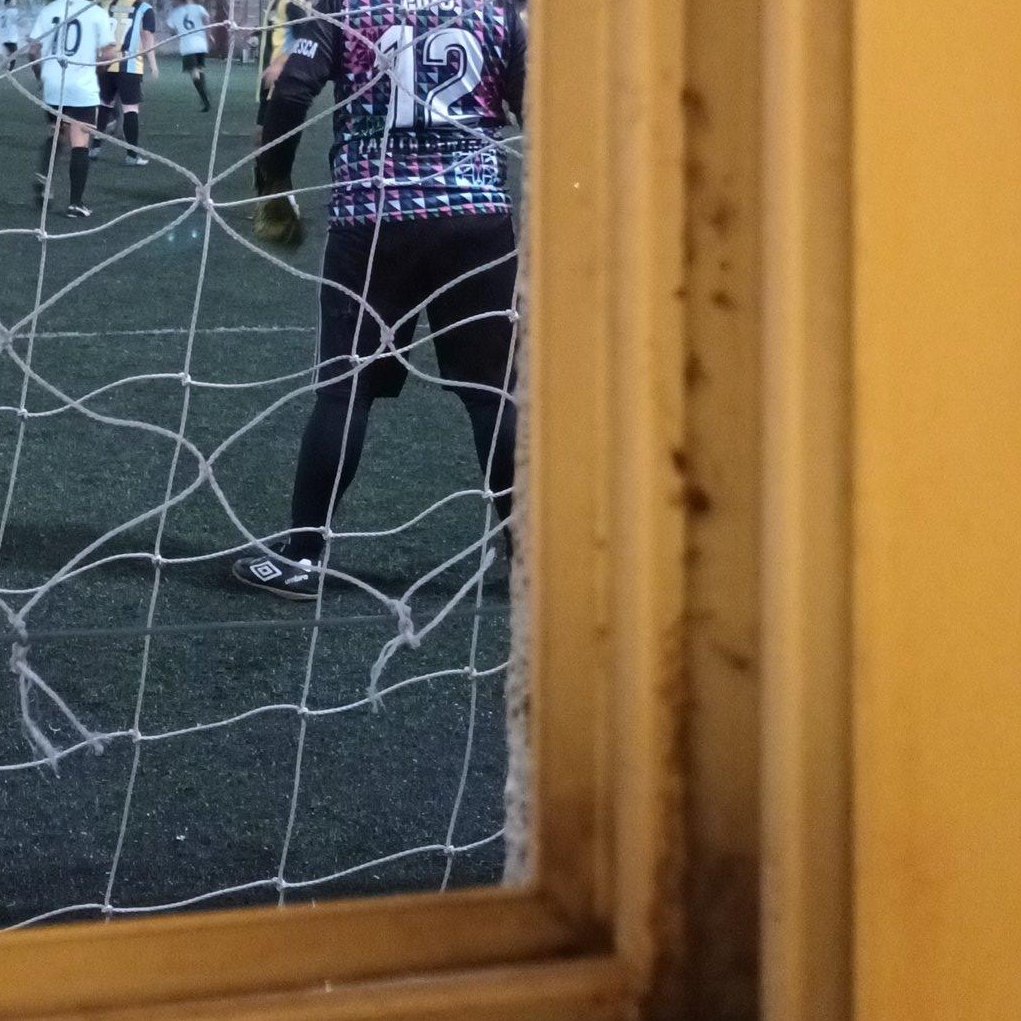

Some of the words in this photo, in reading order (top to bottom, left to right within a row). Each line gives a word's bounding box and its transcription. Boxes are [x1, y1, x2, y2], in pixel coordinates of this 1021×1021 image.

[51, 16, 82, 57] 10
[183, 13, 196, 31] 6
[374, 25, 484, 129] 12
